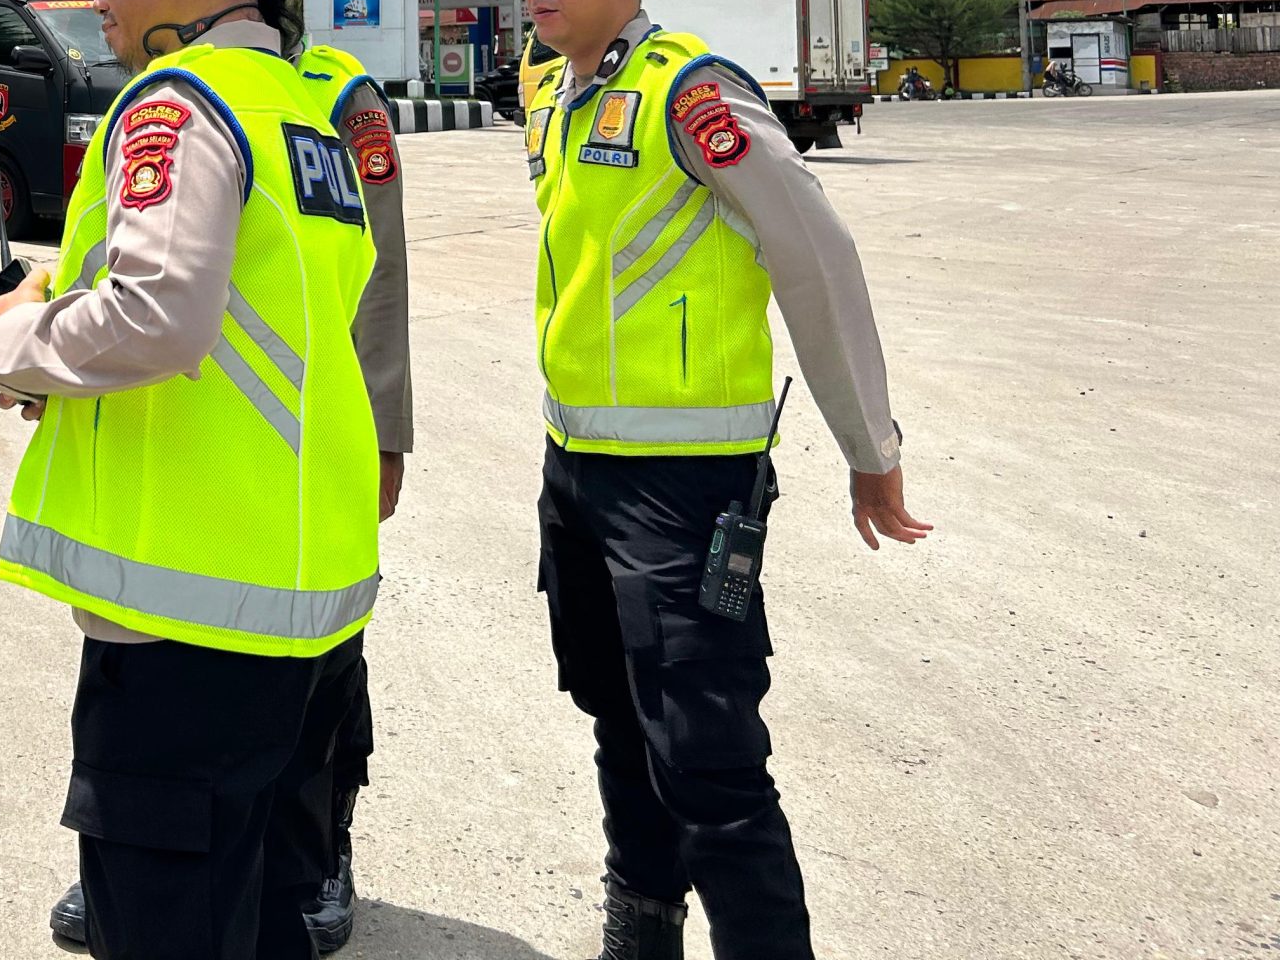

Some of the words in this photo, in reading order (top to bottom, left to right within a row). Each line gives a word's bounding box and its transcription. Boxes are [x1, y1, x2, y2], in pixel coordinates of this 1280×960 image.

[674, 85, 711, 112] POLRES
[131, 105, 182, 121] POLRES
[349, 112, 385, 126] POLRES
[583, 148, 628, 165] POLRI
